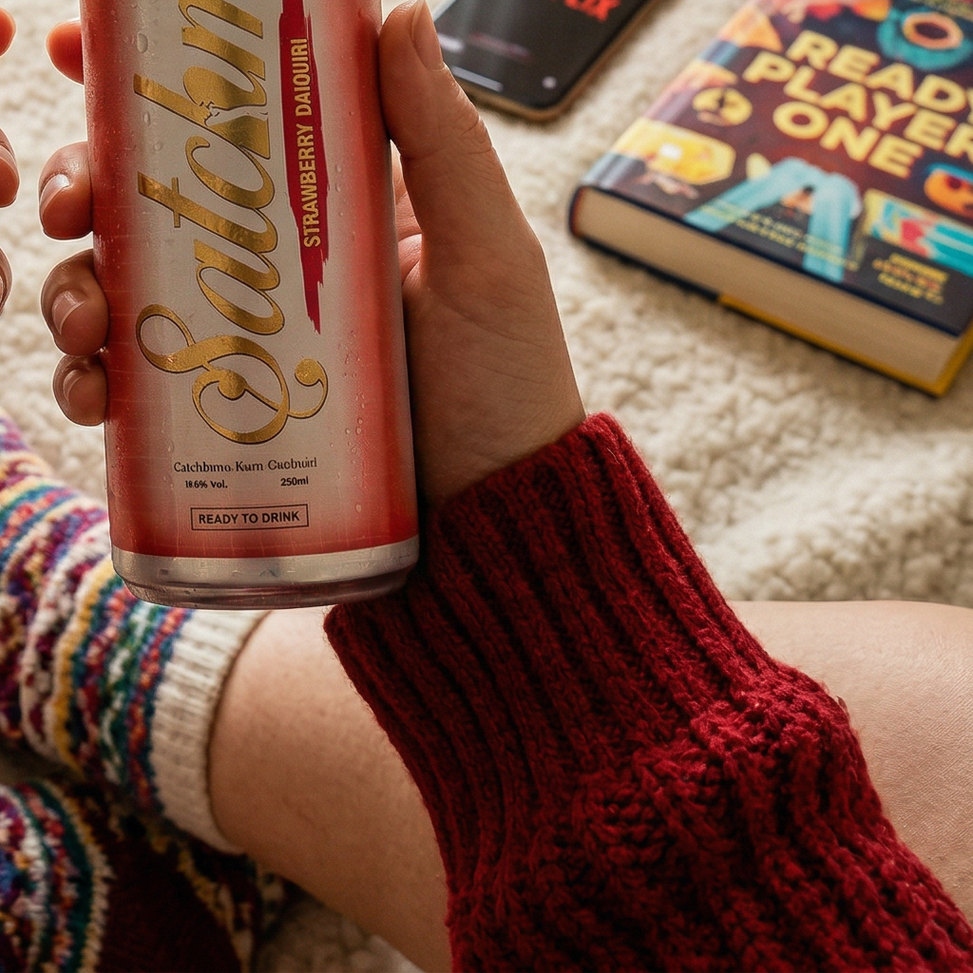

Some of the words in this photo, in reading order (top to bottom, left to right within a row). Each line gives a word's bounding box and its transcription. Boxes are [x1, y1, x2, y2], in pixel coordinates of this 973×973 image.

[785, 29, 973, 125] READ
[772, 100, 923, 179] ONE
[296, 123, 321, 249] STRAWBERRY
[198, 513, 239, 525] READY
[241, 513, 259, 524] TO
[262, 510, 300, 523] DRINK
[280, 475, 309, 487] 250ml
